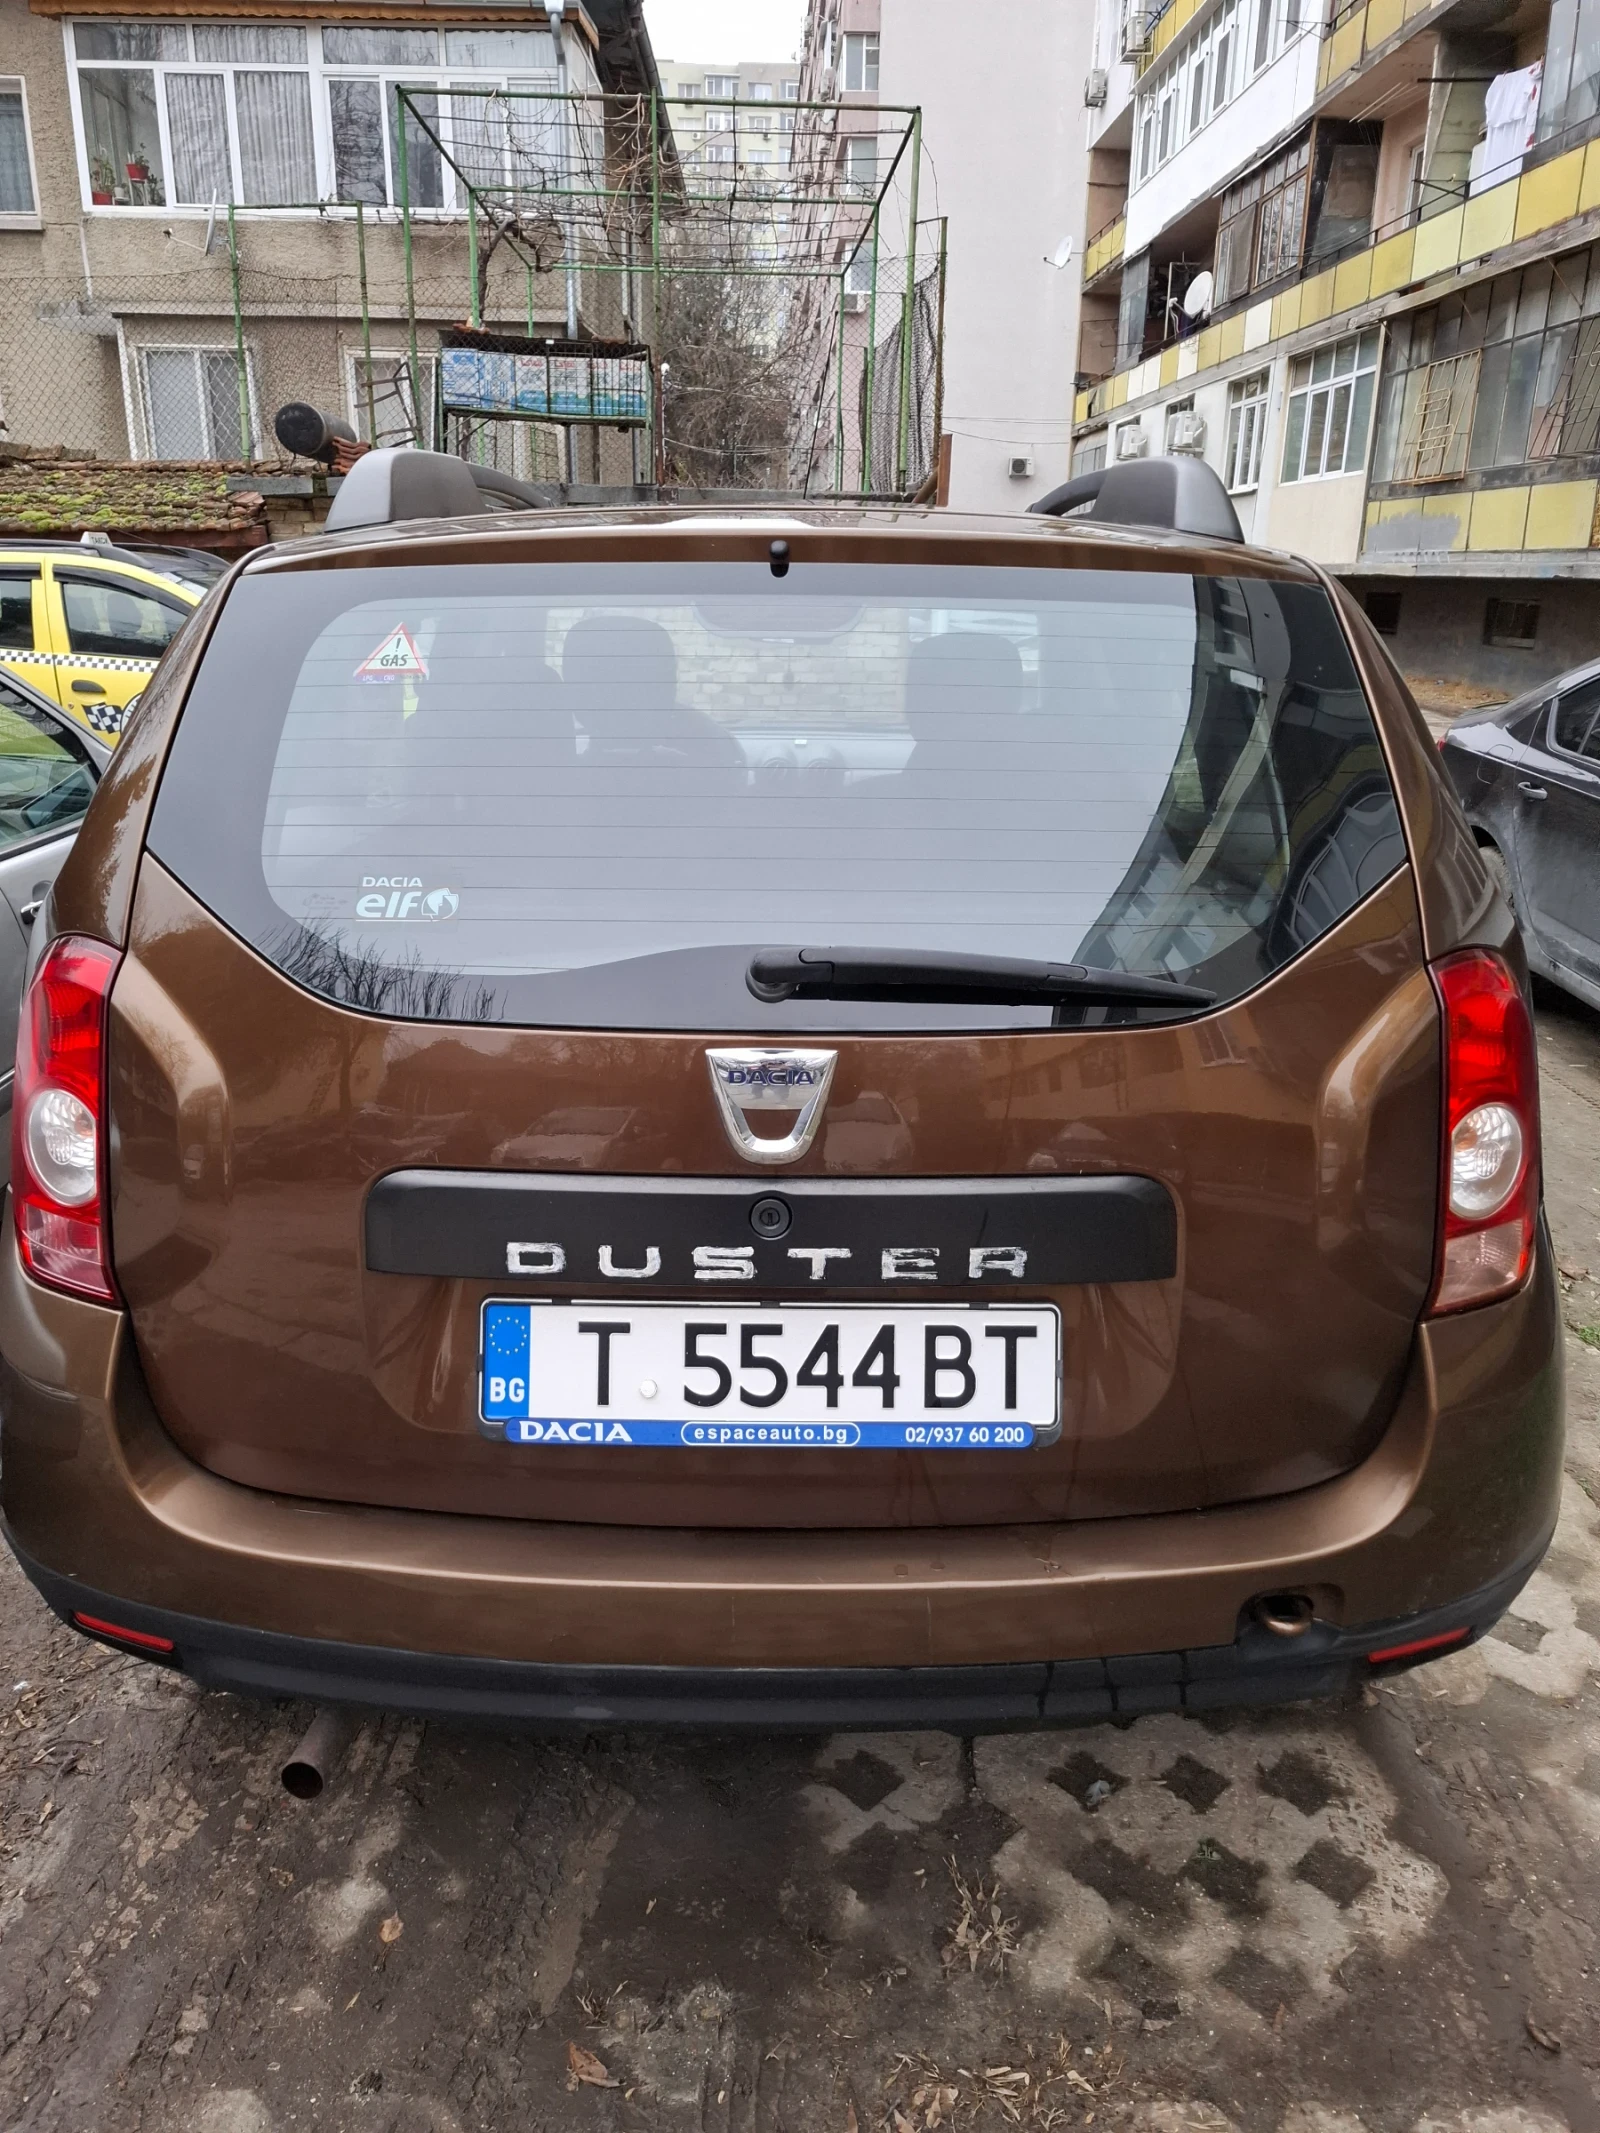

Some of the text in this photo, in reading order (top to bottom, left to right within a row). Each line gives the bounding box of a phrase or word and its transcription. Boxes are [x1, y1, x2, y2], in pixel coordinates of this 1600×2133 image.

[380, 654, 408, 667] GAS
[362, 876, 423, 888] DACIA
[356, 891, 423, 918] elf
[728, 1070, 815, 1086] DACIA
[506, 1241, 1028, 1281] DUSTER
[578, 1320, 1038, 1410] T 5544 BT
[489, 1376, 526, 1403] BG
[519, 1420, 1025, 1445] DACIA espaceauto.bg 02/937 60 200
